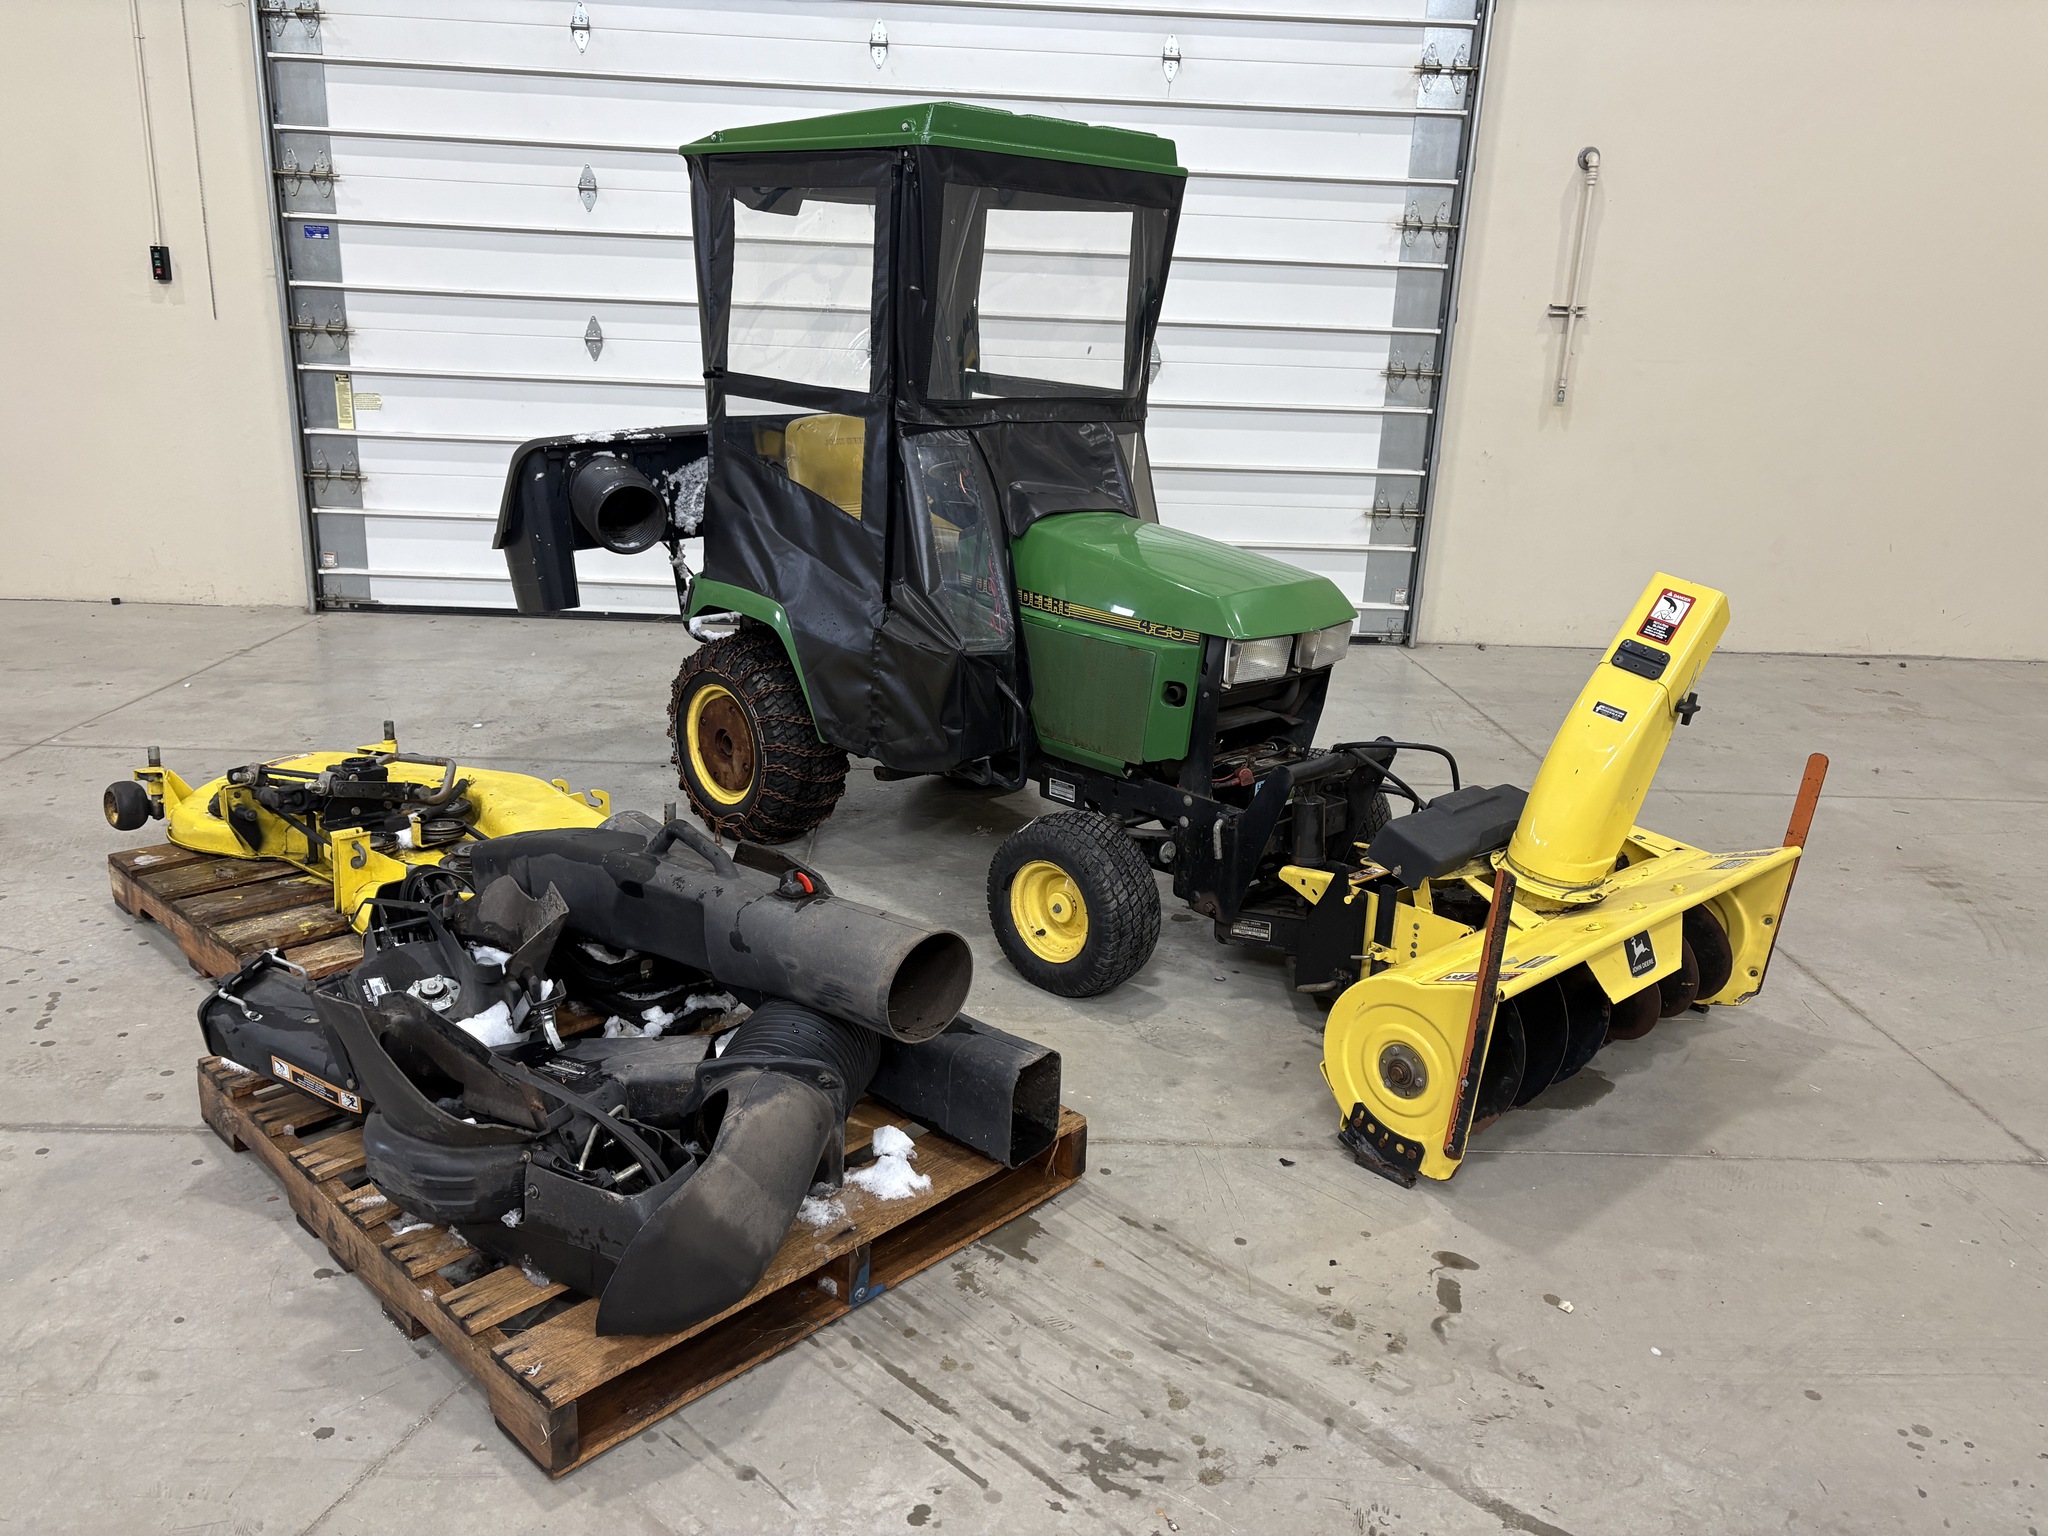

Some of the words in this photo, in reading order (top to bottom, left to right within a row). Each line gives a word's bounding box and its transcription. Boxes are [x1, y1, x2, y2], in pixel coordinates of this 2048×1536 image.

[1021, 588, 1071, 617] DEERE
[1139, 619, 1185, 641] 425
[1632, 964, 1643, 974] JOHN
[1642, 958, 1655, 969] DEERE
